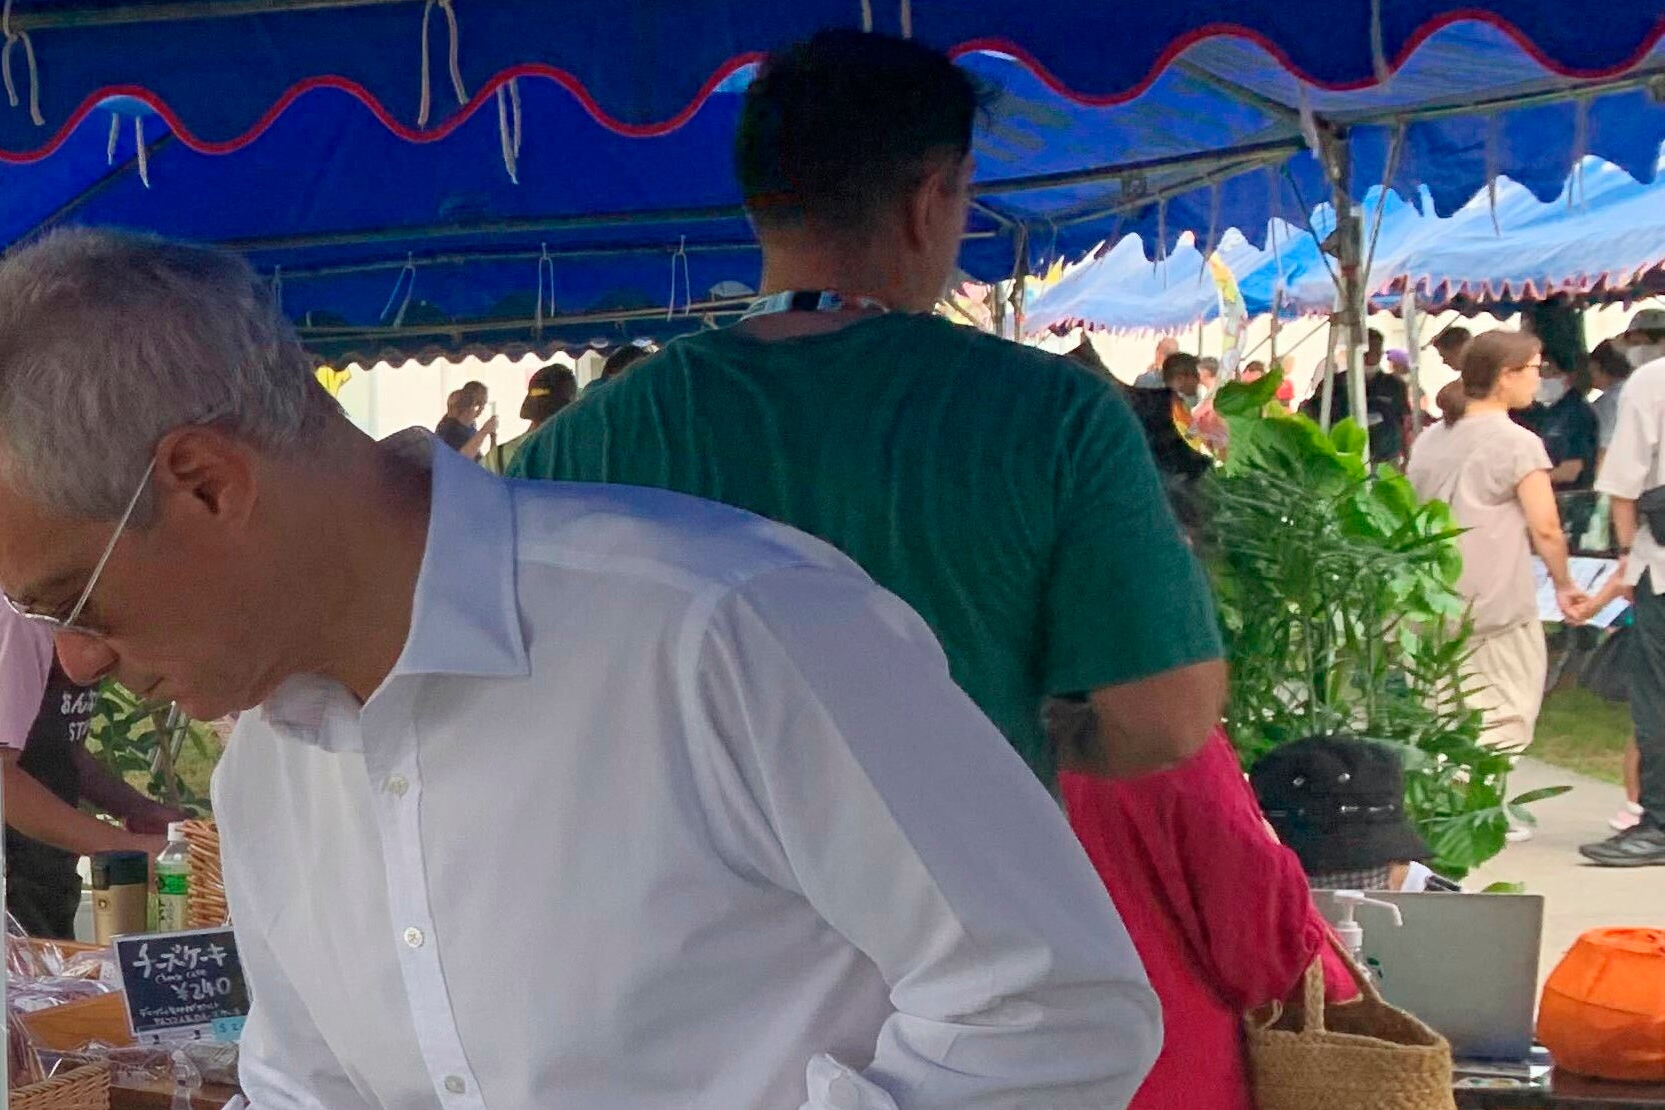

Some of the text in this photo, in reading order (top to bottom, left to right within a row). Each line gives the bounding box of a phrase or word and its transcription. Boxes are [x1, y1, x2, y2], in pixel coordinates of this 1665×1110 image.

[132, 943, 228, 979] チーズケーキ
[170, 976, 231, 1001] ¥240
